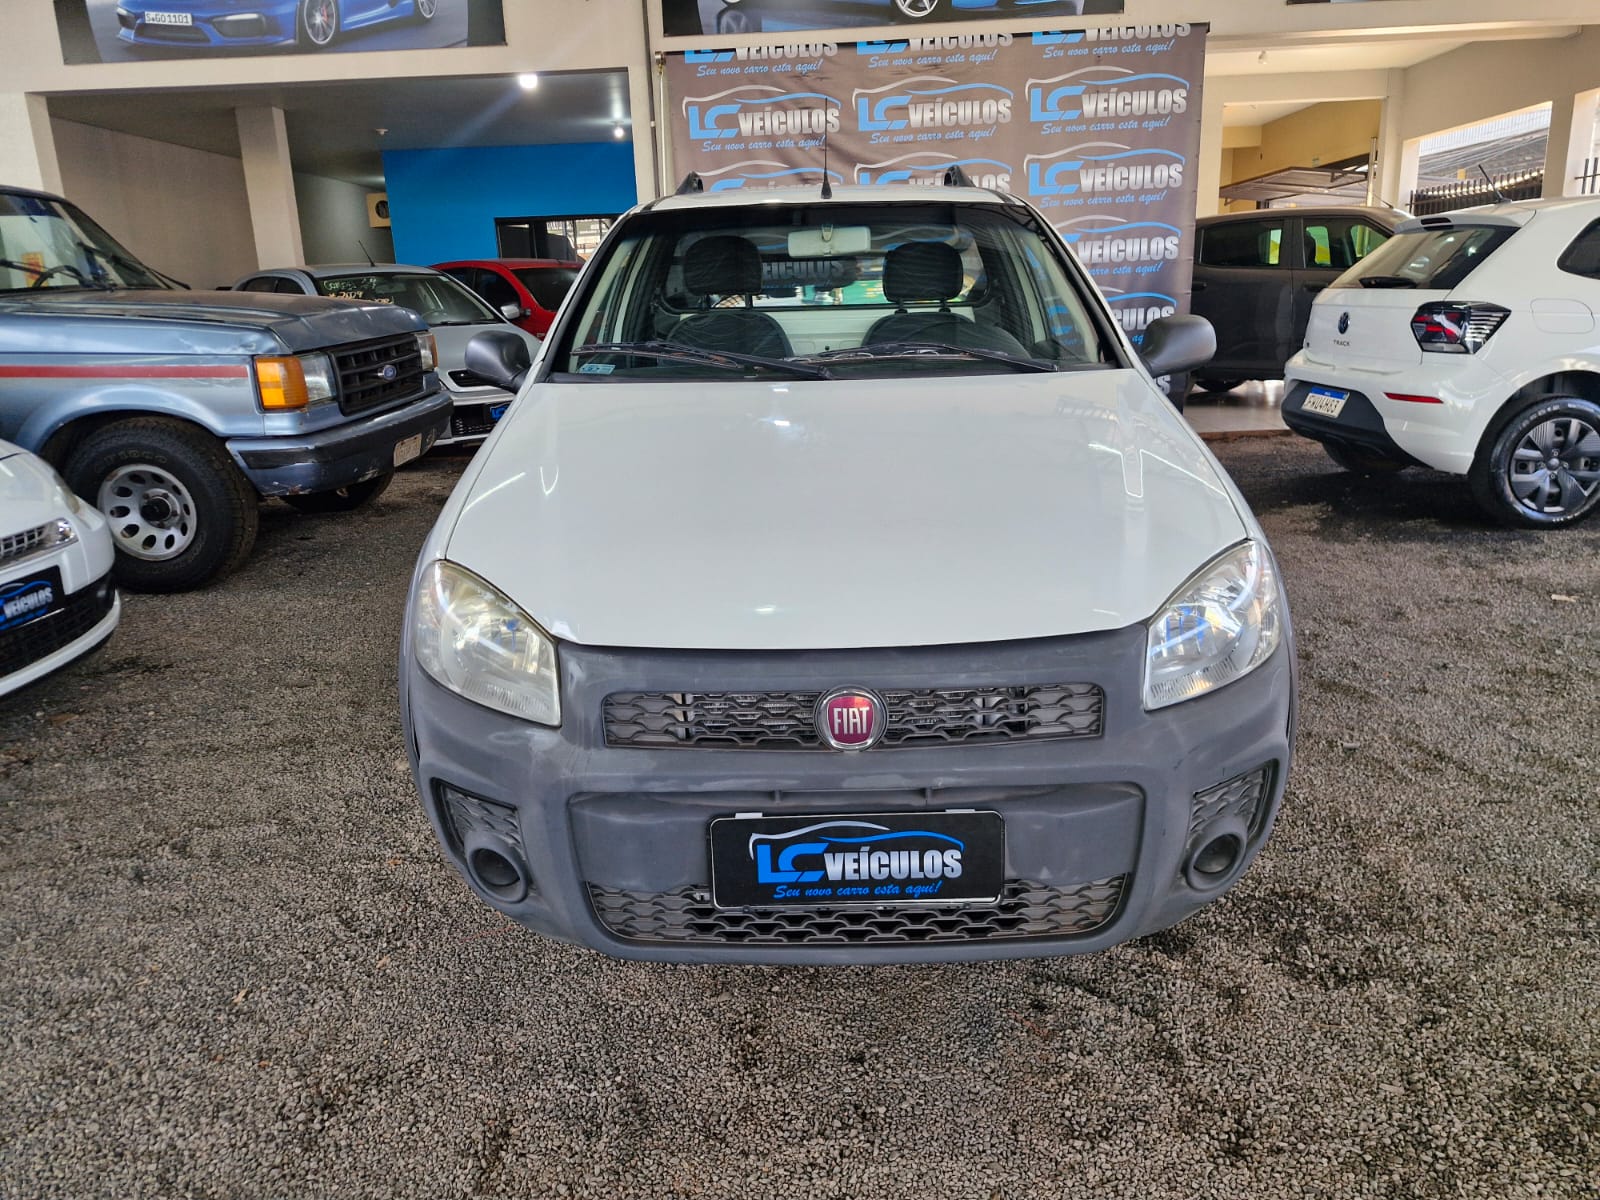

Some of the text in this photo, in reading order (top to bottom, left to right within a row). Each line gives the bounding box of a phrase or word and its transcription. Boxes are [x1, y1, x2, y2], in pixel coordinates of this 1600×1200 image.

[868, 49, 998, 68] Seu novo carro esta aqui!
[1043, 39, 1175, 59] Seu novo carro esta aqui!
[697, 59, 824, 77] Seu novo carro esta aqui!
[857, 95, 1012, 132] LC VEÍCULOS
[1030, 85, 1187, 122] LC VEÍCULOS
[687, 104, 840, 139] LC VEÍCULOS
[1041, 115, 1171, 135] Seu novo carro esta aqui!
[702, 140, 721, 152] Seu
[725, 142, 745, 150] novo
[775, 139, 795, 148] esta
[798, 135, 826, 150] aqui!
[869, 125, 997, 144] Seu novo carro esta aqui!
[1028, 160, 1084, 196] LC
[1079, 163, 1183, 193] VEÍCULOS
[1077, 235, 1179, 263] VEÍCULOS
[833, 707, 870, 735] FIAT
[756, 842, 962, 884] LC VEÍCULOS
[773, 880, 943, 898] Seu novo carro esta aqui!
